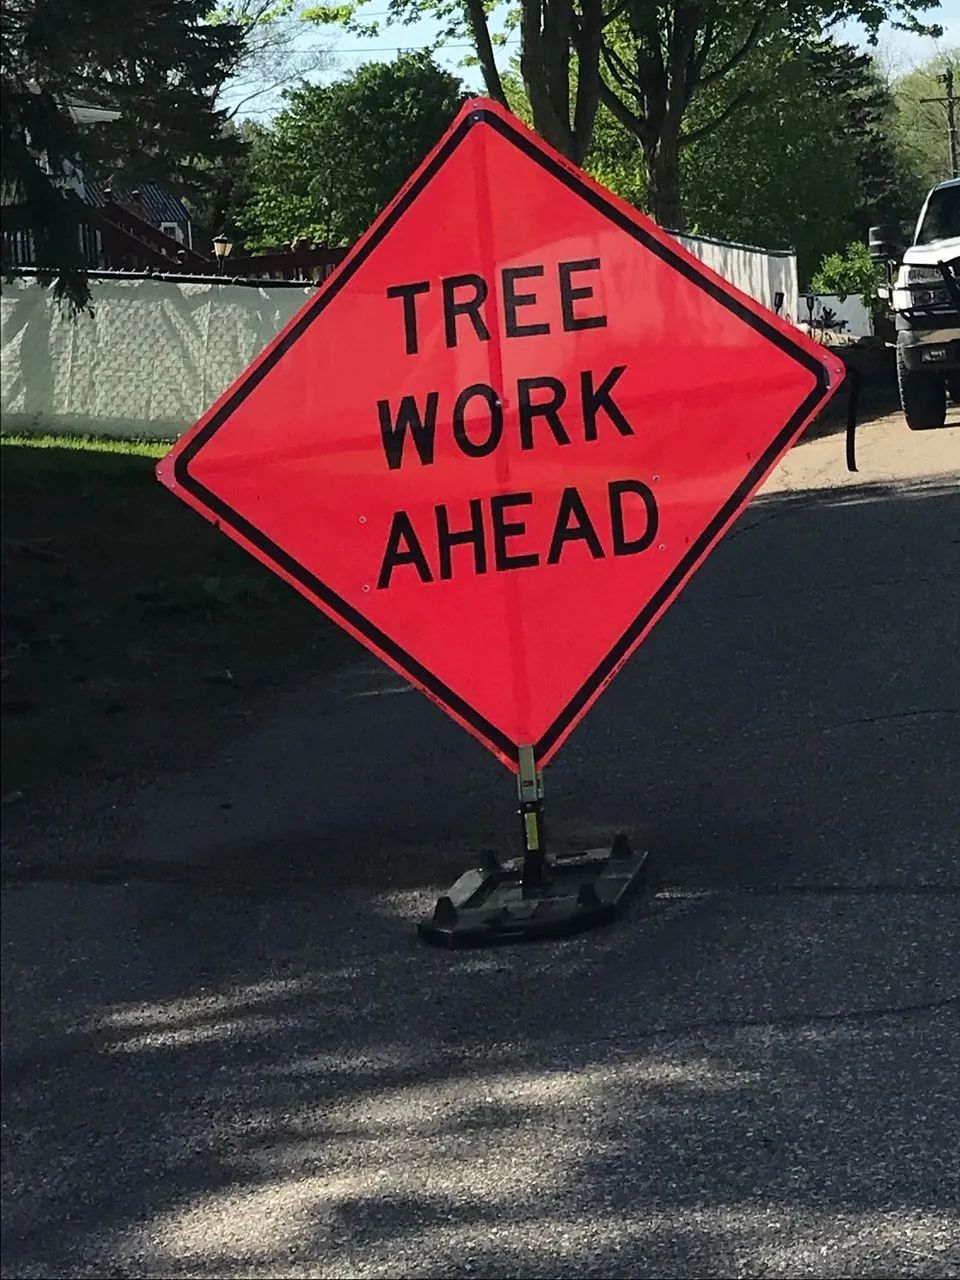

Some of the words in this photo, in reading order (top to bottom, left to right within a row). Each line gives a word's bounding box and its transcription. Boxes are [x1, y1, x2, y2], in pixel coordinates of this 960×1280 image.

[386, 257, 608, 355] TREE
[376, 365, 635, 470] WORK
[376, 479, 660, 590] AHEAD
